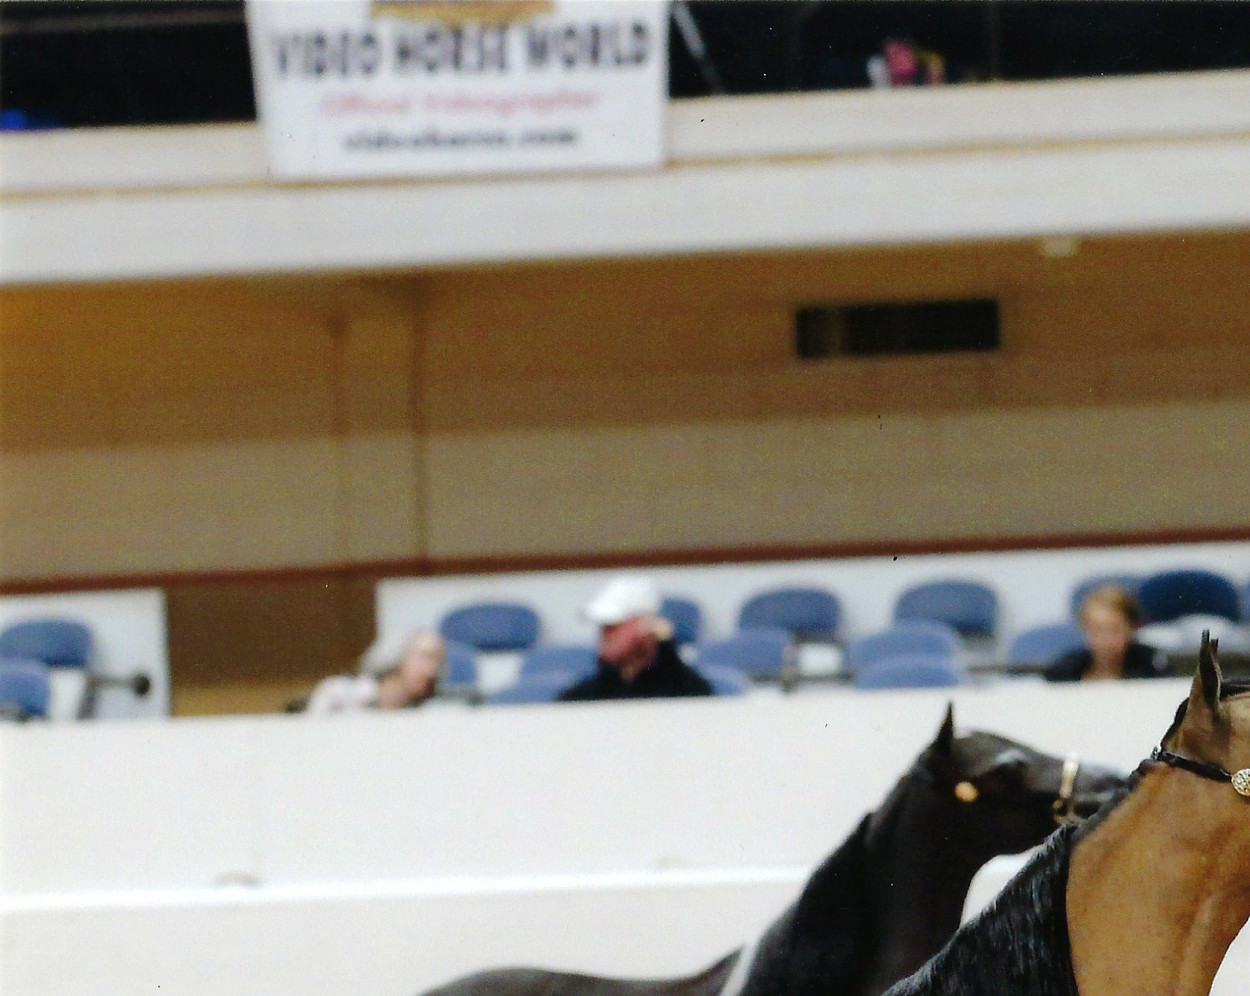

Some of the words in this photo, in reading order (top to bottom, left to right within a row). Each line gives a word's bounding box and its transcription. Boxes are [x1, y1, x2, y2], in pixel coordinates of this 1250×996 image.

[272, 30, 383, 78] VIDEO
[392, 22, 511, 76] HORSE
[524, 18, 649, 71] WORLD
